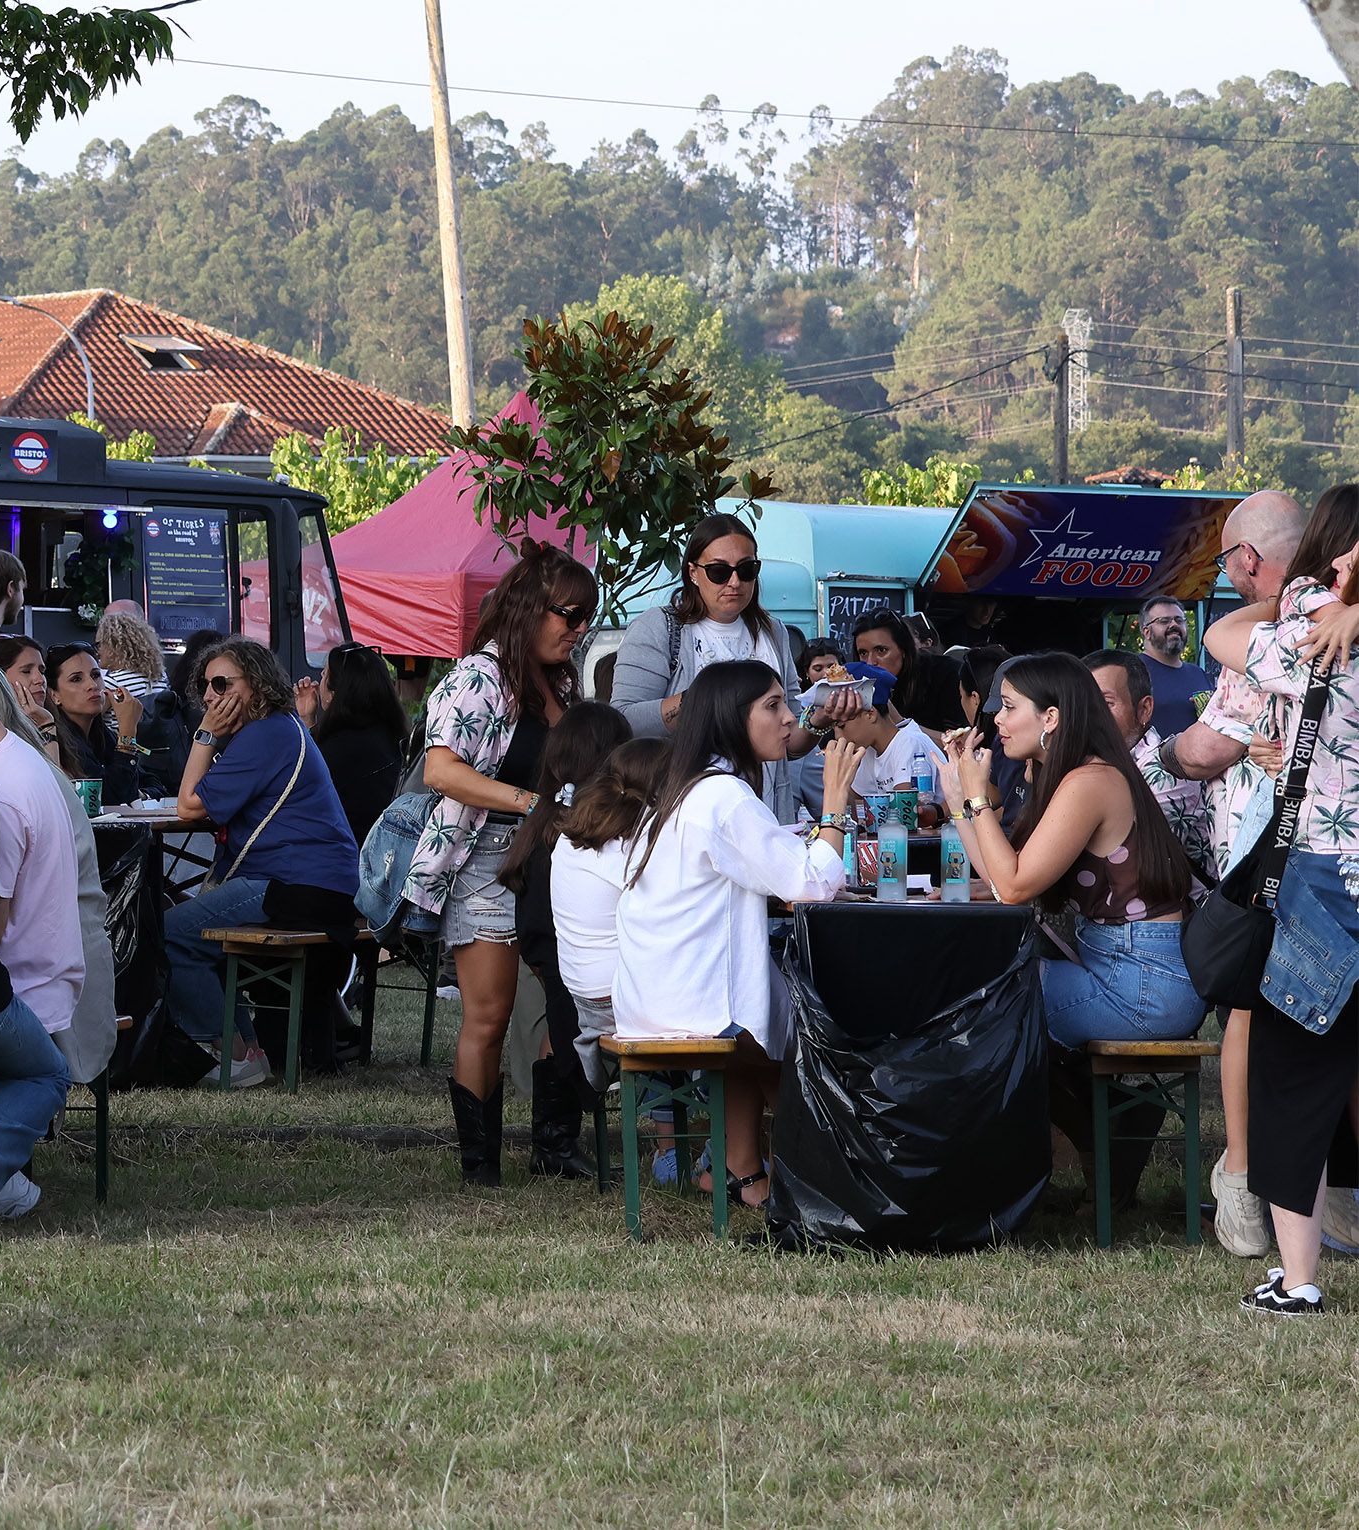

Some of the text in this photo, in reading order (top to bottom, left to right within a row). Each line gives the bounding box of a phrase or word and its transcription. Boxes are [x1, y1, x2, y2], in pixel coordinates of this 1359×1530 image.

[14, 449, 48, 458] BRISTOL
[162, 518, 205, 529] OS TIGRES
[1047, 543, 1161, 562] American
[1030, 560, 1152, 588] FOOD
[1292, 718, 1318, 771] BIMBA
[88, 787, 98, 813] 1906
[901, 799, 912, 826] 1906
[1274, 800, 1300, 849] BIMBA
